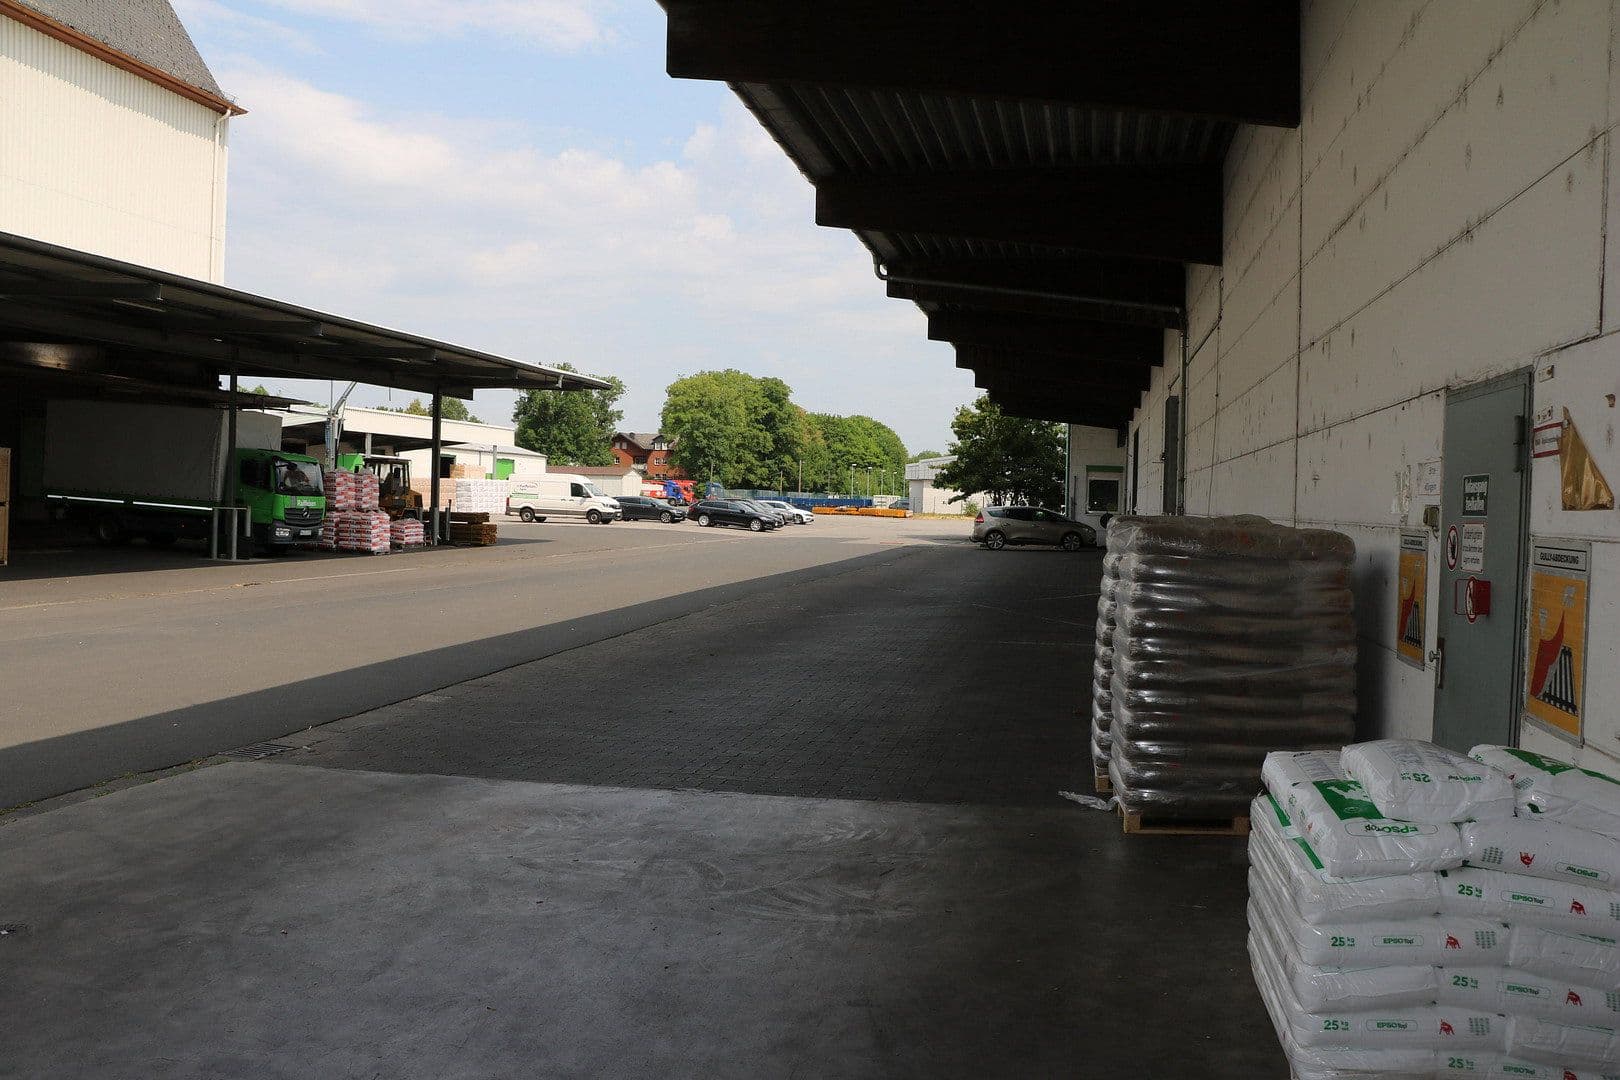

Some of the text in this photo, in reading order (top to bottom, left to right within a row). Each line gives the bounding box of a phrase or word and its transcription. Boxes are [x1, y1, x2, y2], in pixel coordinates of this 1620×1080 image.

[1412, 773, 1431, 782] 25
[1458, 884, 1473, 896] 25
[1331, 936, 1346, 947] 25
[1453, 975, 1469, 987] 25
[1323, 1020, 1339, 1030] 25
[1448, 1057, 1464, 1069] 25
